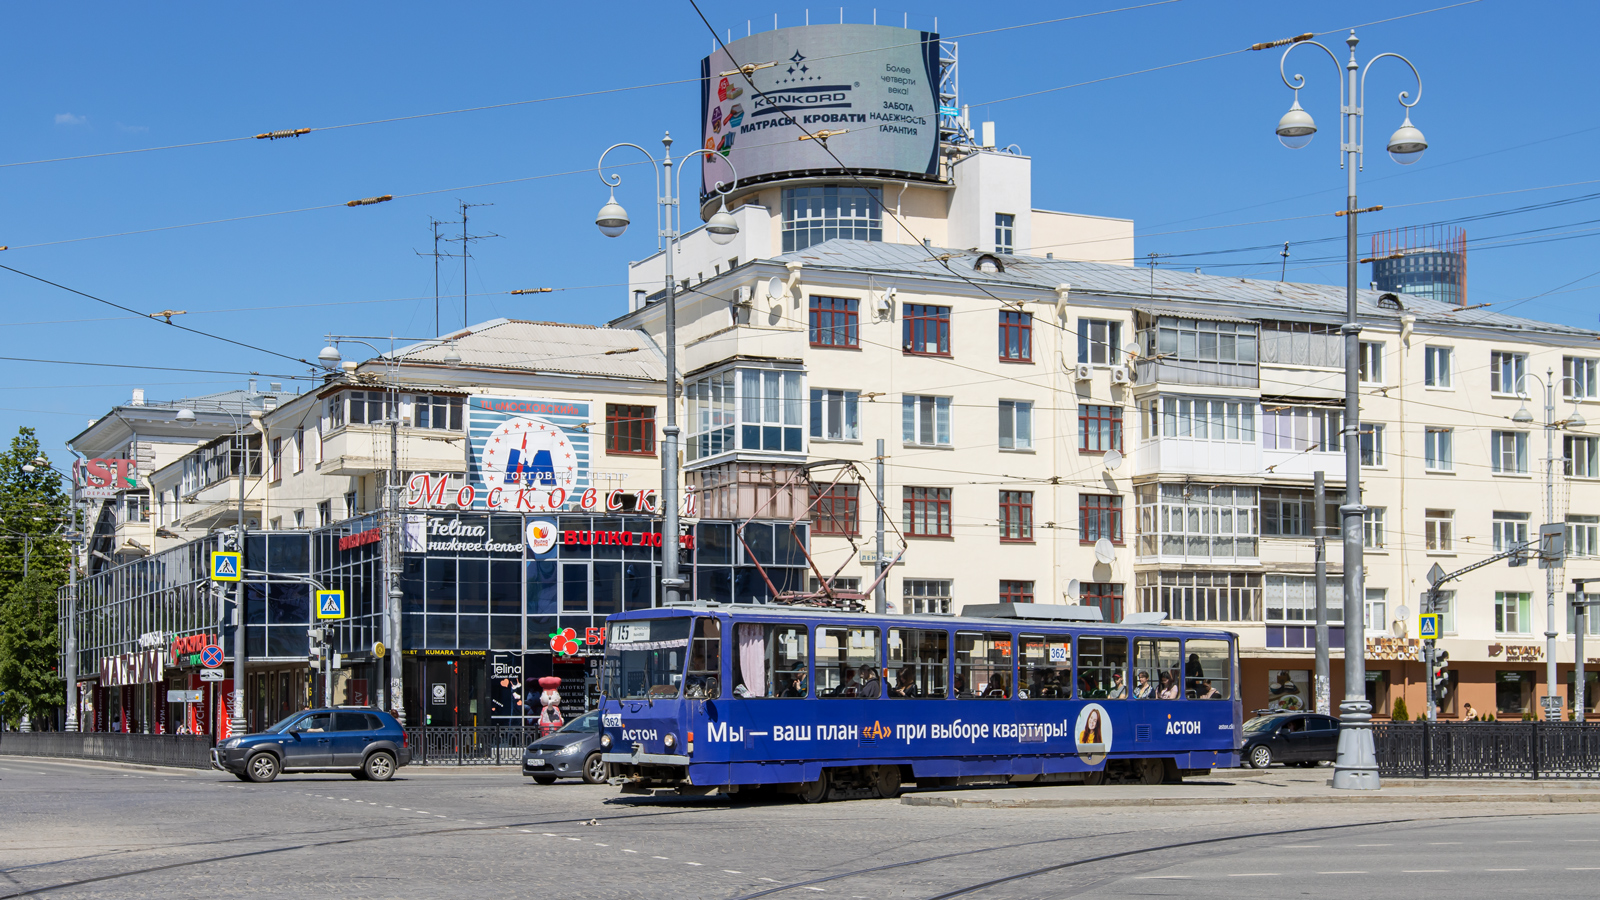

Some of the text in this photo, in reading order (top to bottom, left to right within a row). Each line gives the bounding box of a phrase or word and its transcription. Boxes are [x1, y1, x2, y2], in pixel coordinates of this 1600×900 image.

[885, 63, 911, 75] Более
[881, 75, 916, 86] четверти
[887, 86, 909, 96] века!
[754, 93, 846, 109] KONKORD
[882, 100, 914, 112] ЗАБОТА
[740, 113, 867, 134] МАТРАСЫ КРОВАТИ
[869, 112, 927, 126] НАДЕЖНОСТЬ
[879, 124, 918, 136] ГАРАНТИЯ
[480, 400, 579, 415] ТЦ «МОСКОВСКИЙ»
[407, 472, 697, 517] Московскй
[428, 517, 486, 537] Felina
[427, 537, 524, 553] нижнее белье
[617, 625, 630, 641] 15
[1050, 648, 1065, 659] 362
[100, 648, 164, 687] МАГНУМ
[490, 654, 522, 674] Felina
[605, 716, 619, 727] 362
[1165, 720, 1201, 735] АСТОН
[622, 729, 658, 741] АСТОН
[707, 721, 744, 743] Мы
[773, 724, 811, 742] ваш
[816, 723, 858, 741] план
[862, 720, 892, 740] «А»
[896, 723, 927, 745] при
[931, 718, 989, 744] выборе
[992, 718, 1068, 743] квартиры!
